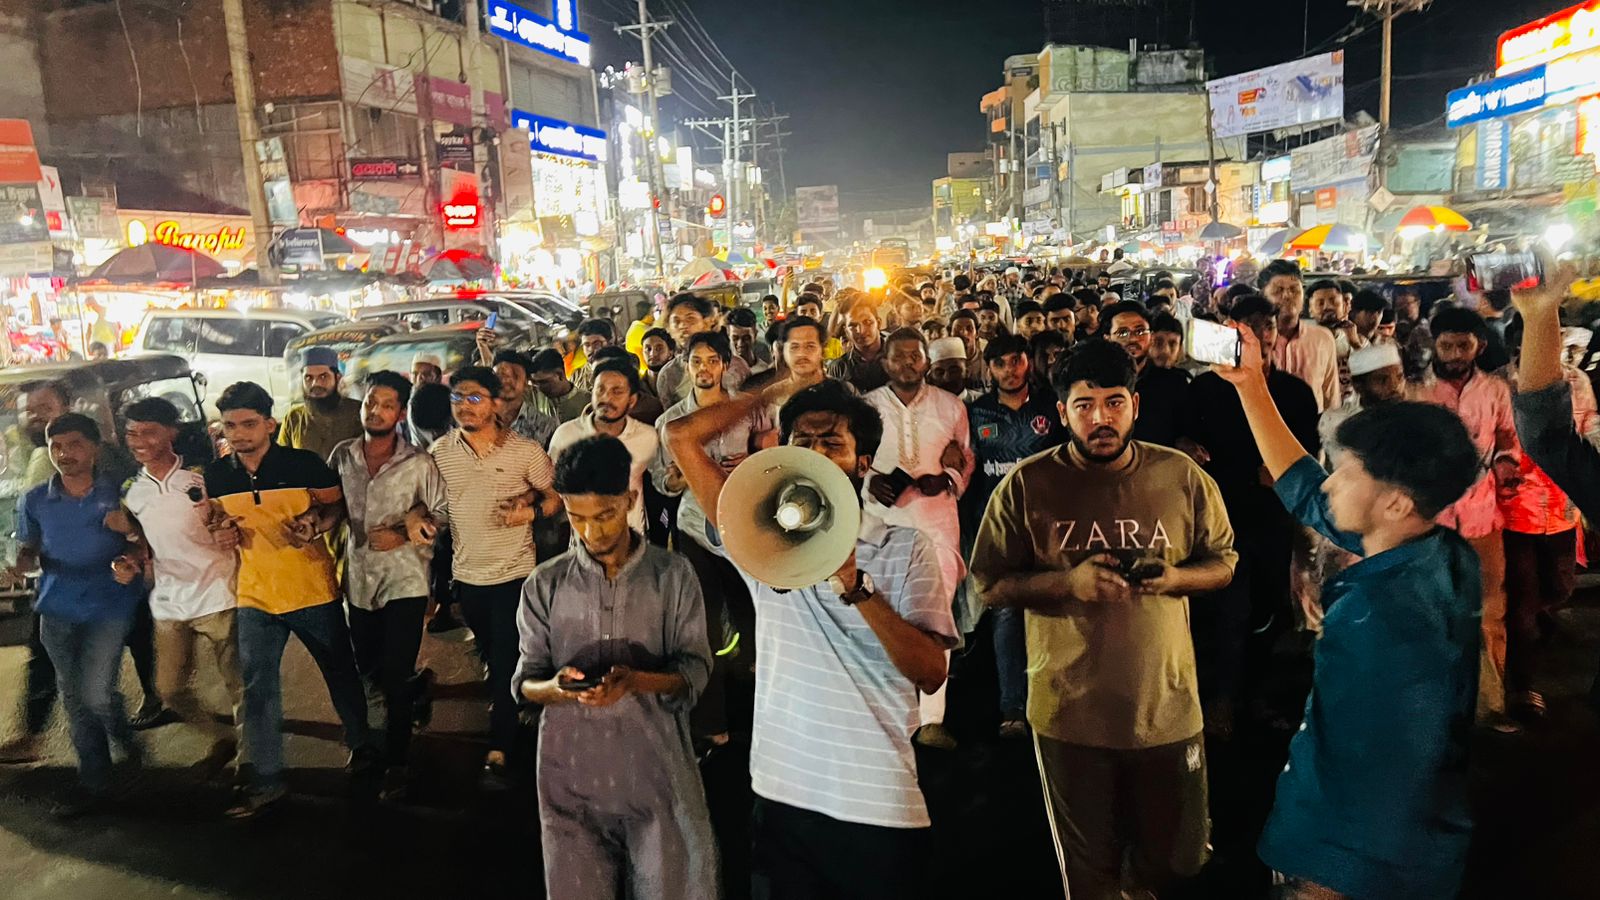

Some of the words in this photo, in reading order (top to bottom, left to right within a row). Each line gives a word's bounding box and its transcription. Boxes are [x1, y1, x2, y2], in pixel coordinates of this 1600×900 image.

[1483, 120, 1503, 188] SAMSUNG
[154, 219, 246, 257] Banoful
[1056, 518, 1173, 551] ZARA
